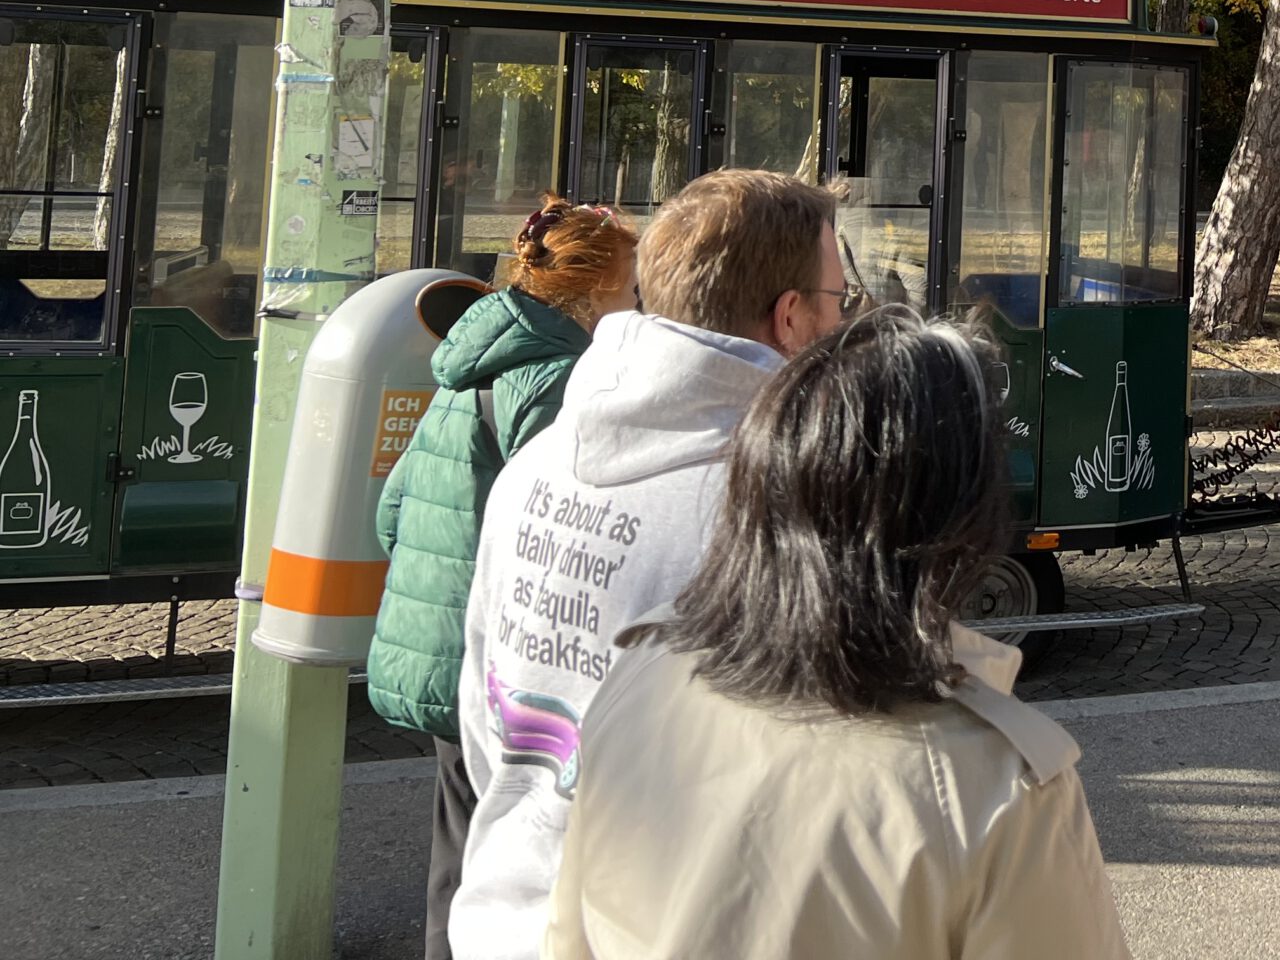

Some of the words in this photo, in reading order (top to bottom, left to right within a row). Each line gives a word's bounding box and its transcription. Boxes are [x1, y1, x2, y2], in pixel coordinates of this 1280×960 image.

[387, 398, 420, 412] ICH
[380, 436, 413, 452] ZU
[523, 477, 552, 518] It's
[554, 492, 611, 536] about
[609, 511, 640, 546] as
[513, 575, 534, 607] as
[534, 577, 599, 636] tequila
